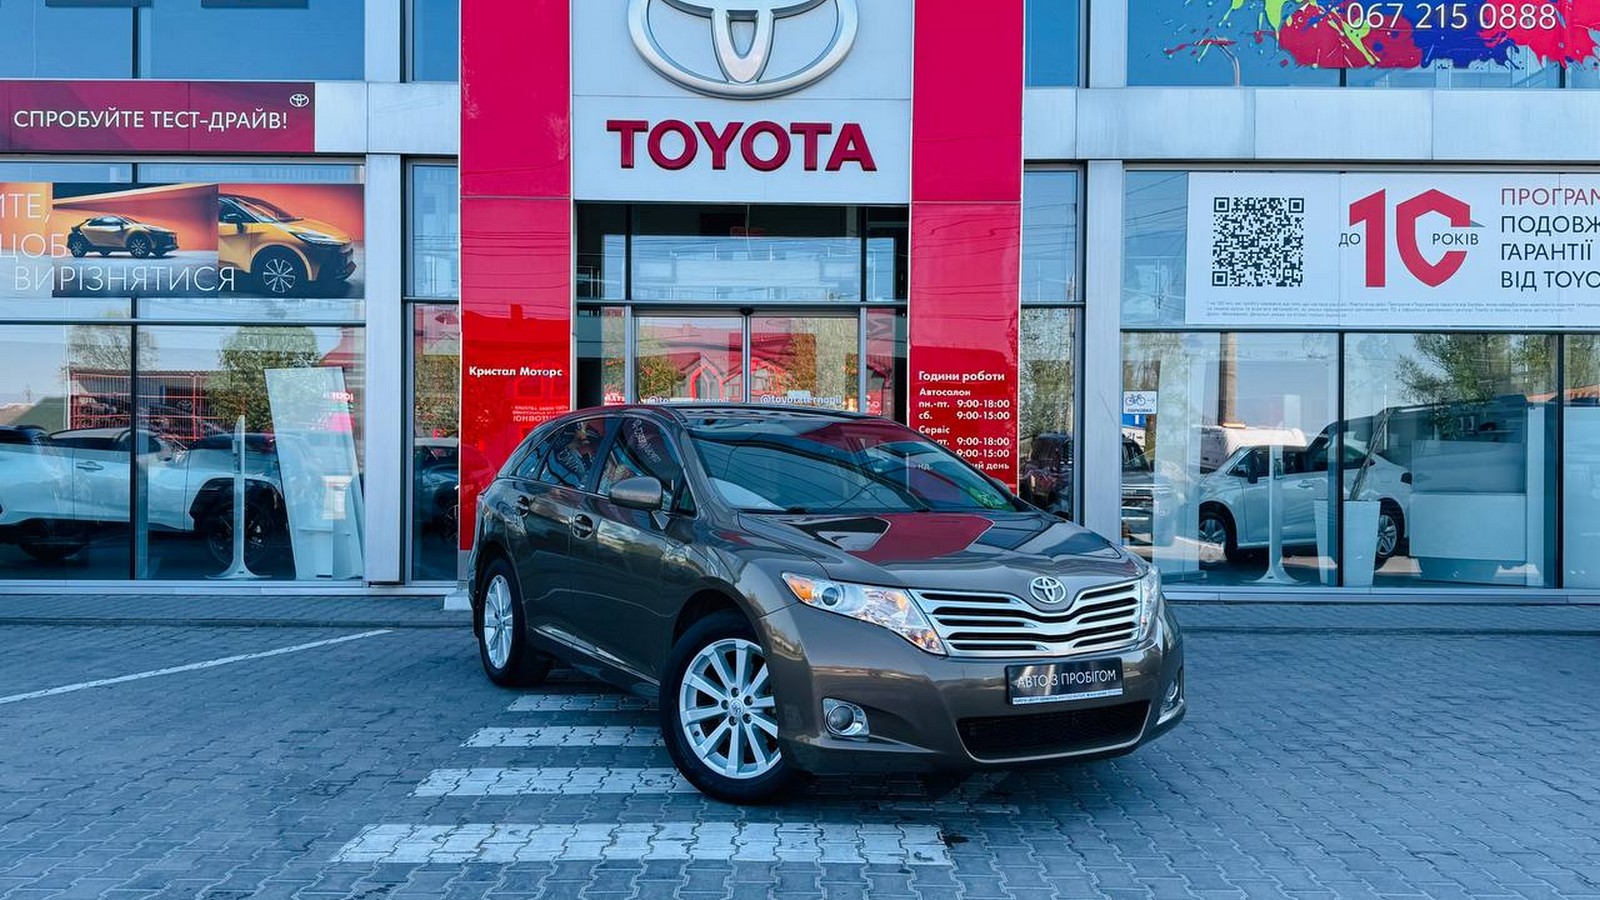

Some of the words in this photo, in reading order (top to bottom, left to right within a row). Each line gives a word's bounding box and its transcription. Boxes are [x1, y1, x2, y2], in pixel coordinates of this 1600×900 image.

[1347, 3, 1403, 29] 067
[1415, 3, 1467, 28] 215
[1479, 3, 1556, 30] 0888
[14, 107, 144, 128] СПРОБУЙТЕ
[151, 108, 288, 132] ТЕСТ-ДРАЙВ!
[606, 119, 877, 172] TOYOTA
[1338, 233, 1361, 247] ДО
[1432, 233, 1479, 245] РОКІВ
[1501, 239, 1592, 260] ГАРАНТІЇ
[14, 265, 236, 291] ВИРІЗНЯТИСЯ
[1501, 271, 1537, 291] ВІД
[469, 366, 516, 378] Кристал
[520, 367, 563, 378] Моторс
[918, 371, 960, 382] Години
[962, 370, 1005, 383] роботи
[919, 387, 971, 396] Автосалон
[956, 399, 1010, 408] 9:00-18:00
[918, 411, 933, 420] сб.
[956, 411, 1010, 420] 9:00-15:00
[918, 425, 950, 435] Сервіс
[956, 437, 1010, 446] 9:00-18:00
[986, 463, 1010, 471] день
[1017, 674, 1048, 688] АВТО
[1061, 669, 1117, 685] ПРОБІГОМ
